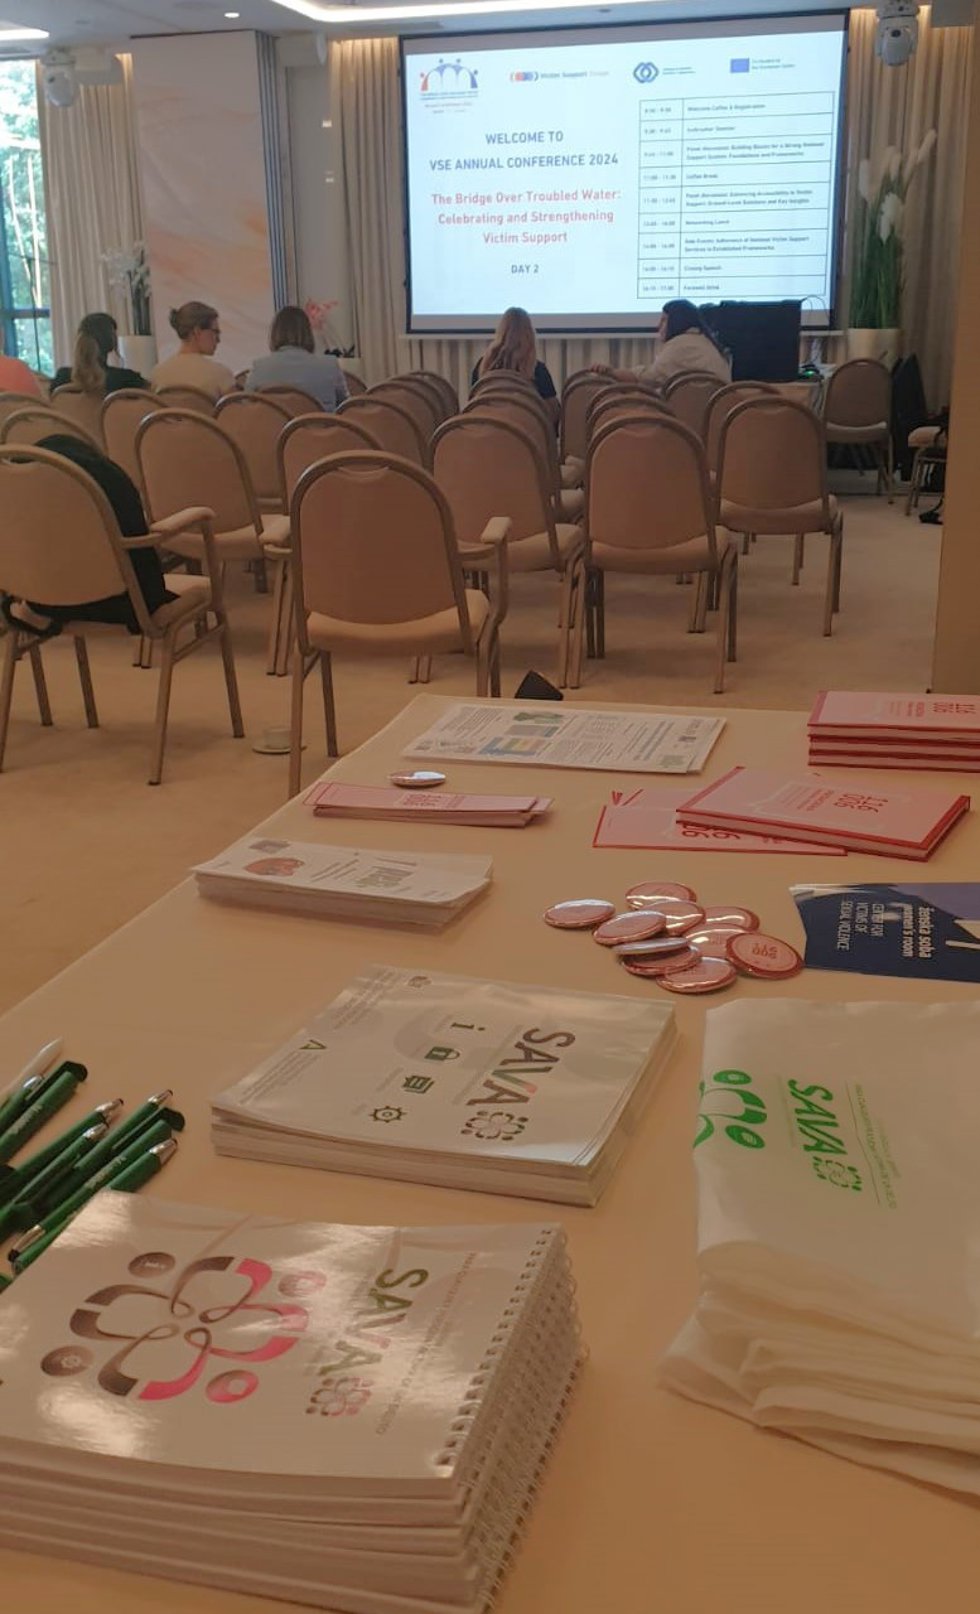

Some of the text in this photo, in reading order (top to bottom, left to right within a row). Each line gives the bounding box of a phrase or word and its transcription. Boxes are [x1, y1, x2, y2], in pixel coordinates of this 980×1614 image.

[485, 131, 563, 144] WELCOME TO
[430, 154, 618, 171] VSE ANNUAL CONFERENCE 2024
[432, 189, 621, 206] The Bridge Over Troubled Water:
[439, 210, 613, 225] Celebrating and Strengthening
[483, 232, 567, 244] Victim Support
[511, 264, 539, 274] DAY 2
[902, 936, 913, 957] room
[919, 936, 935, 958] soba
[466, 1027, 576, 1107] SAVA
[788, 1078, 849, 1157] SAVA
[317, 1268, 429, 1376] SAVA
